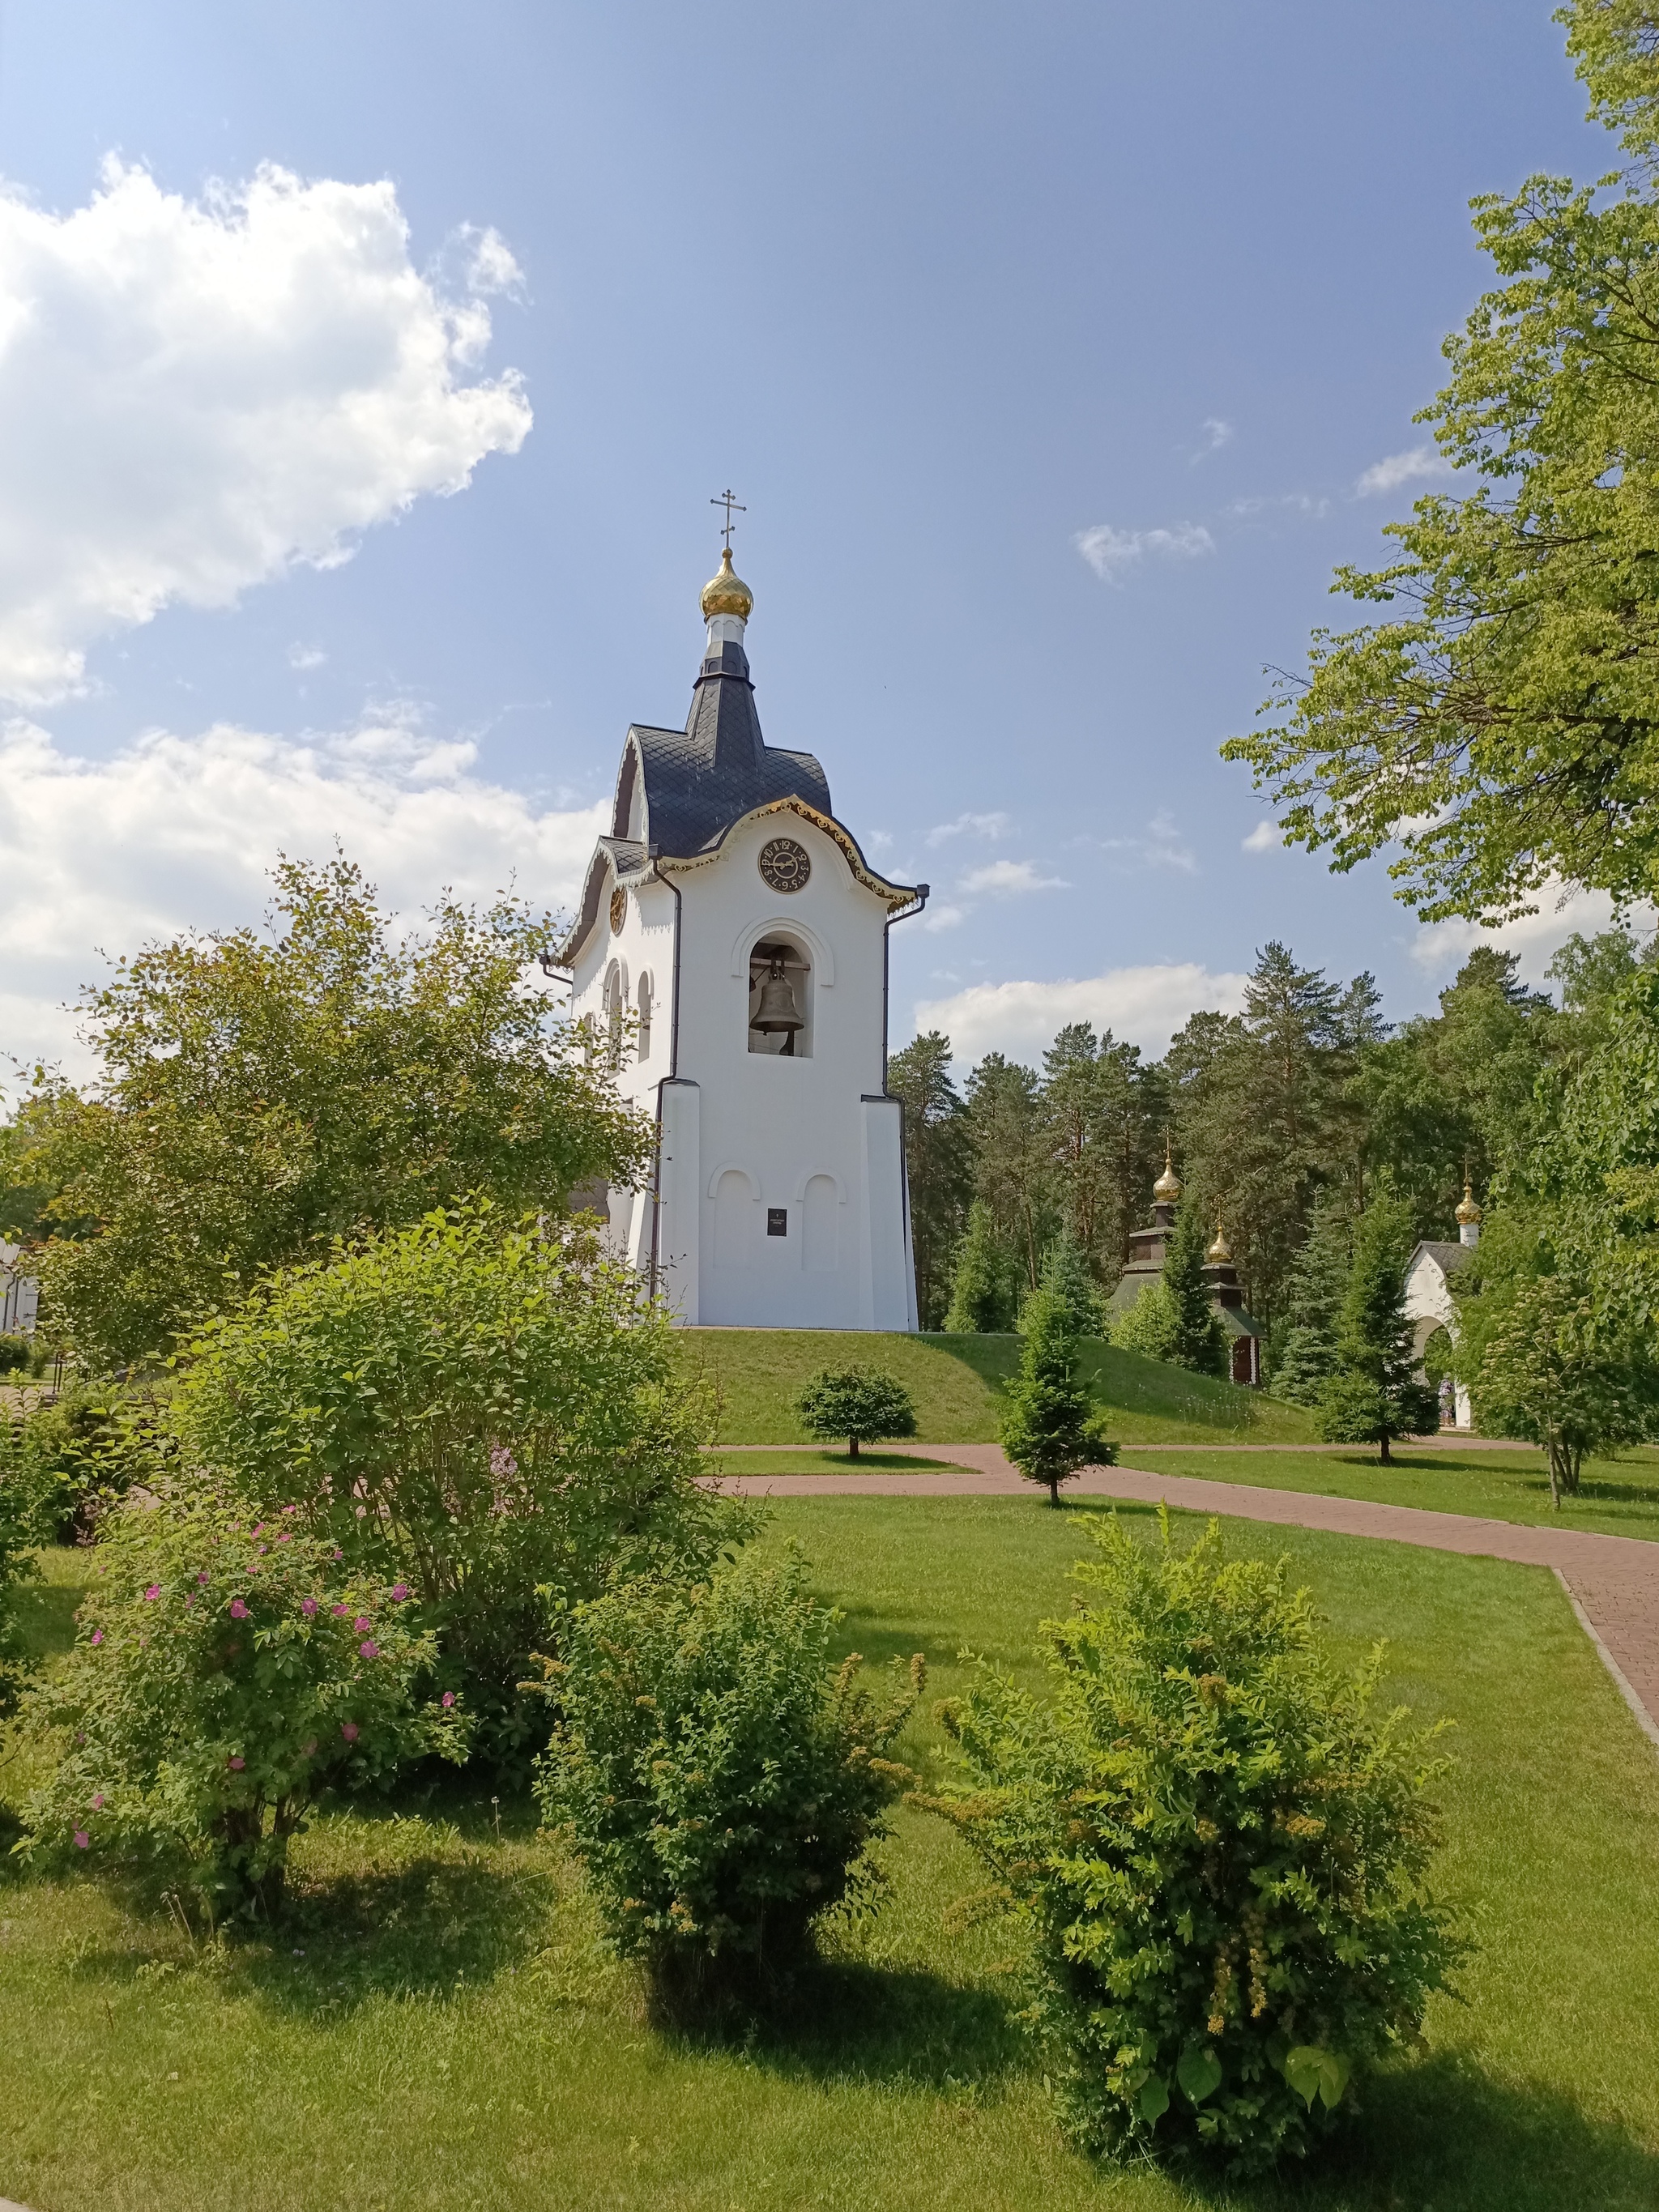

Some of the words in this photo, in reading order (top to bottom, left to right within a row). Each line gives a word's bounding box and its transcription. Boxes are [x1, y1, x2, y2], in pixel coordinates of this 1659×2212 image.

[773, 842, 780, 851] 11
[782, 840, 790, 850] 12
[764, 848, 773, 858] 10
[782, 881, 788, 890] 6
[791, 879, 798, 889] 5
